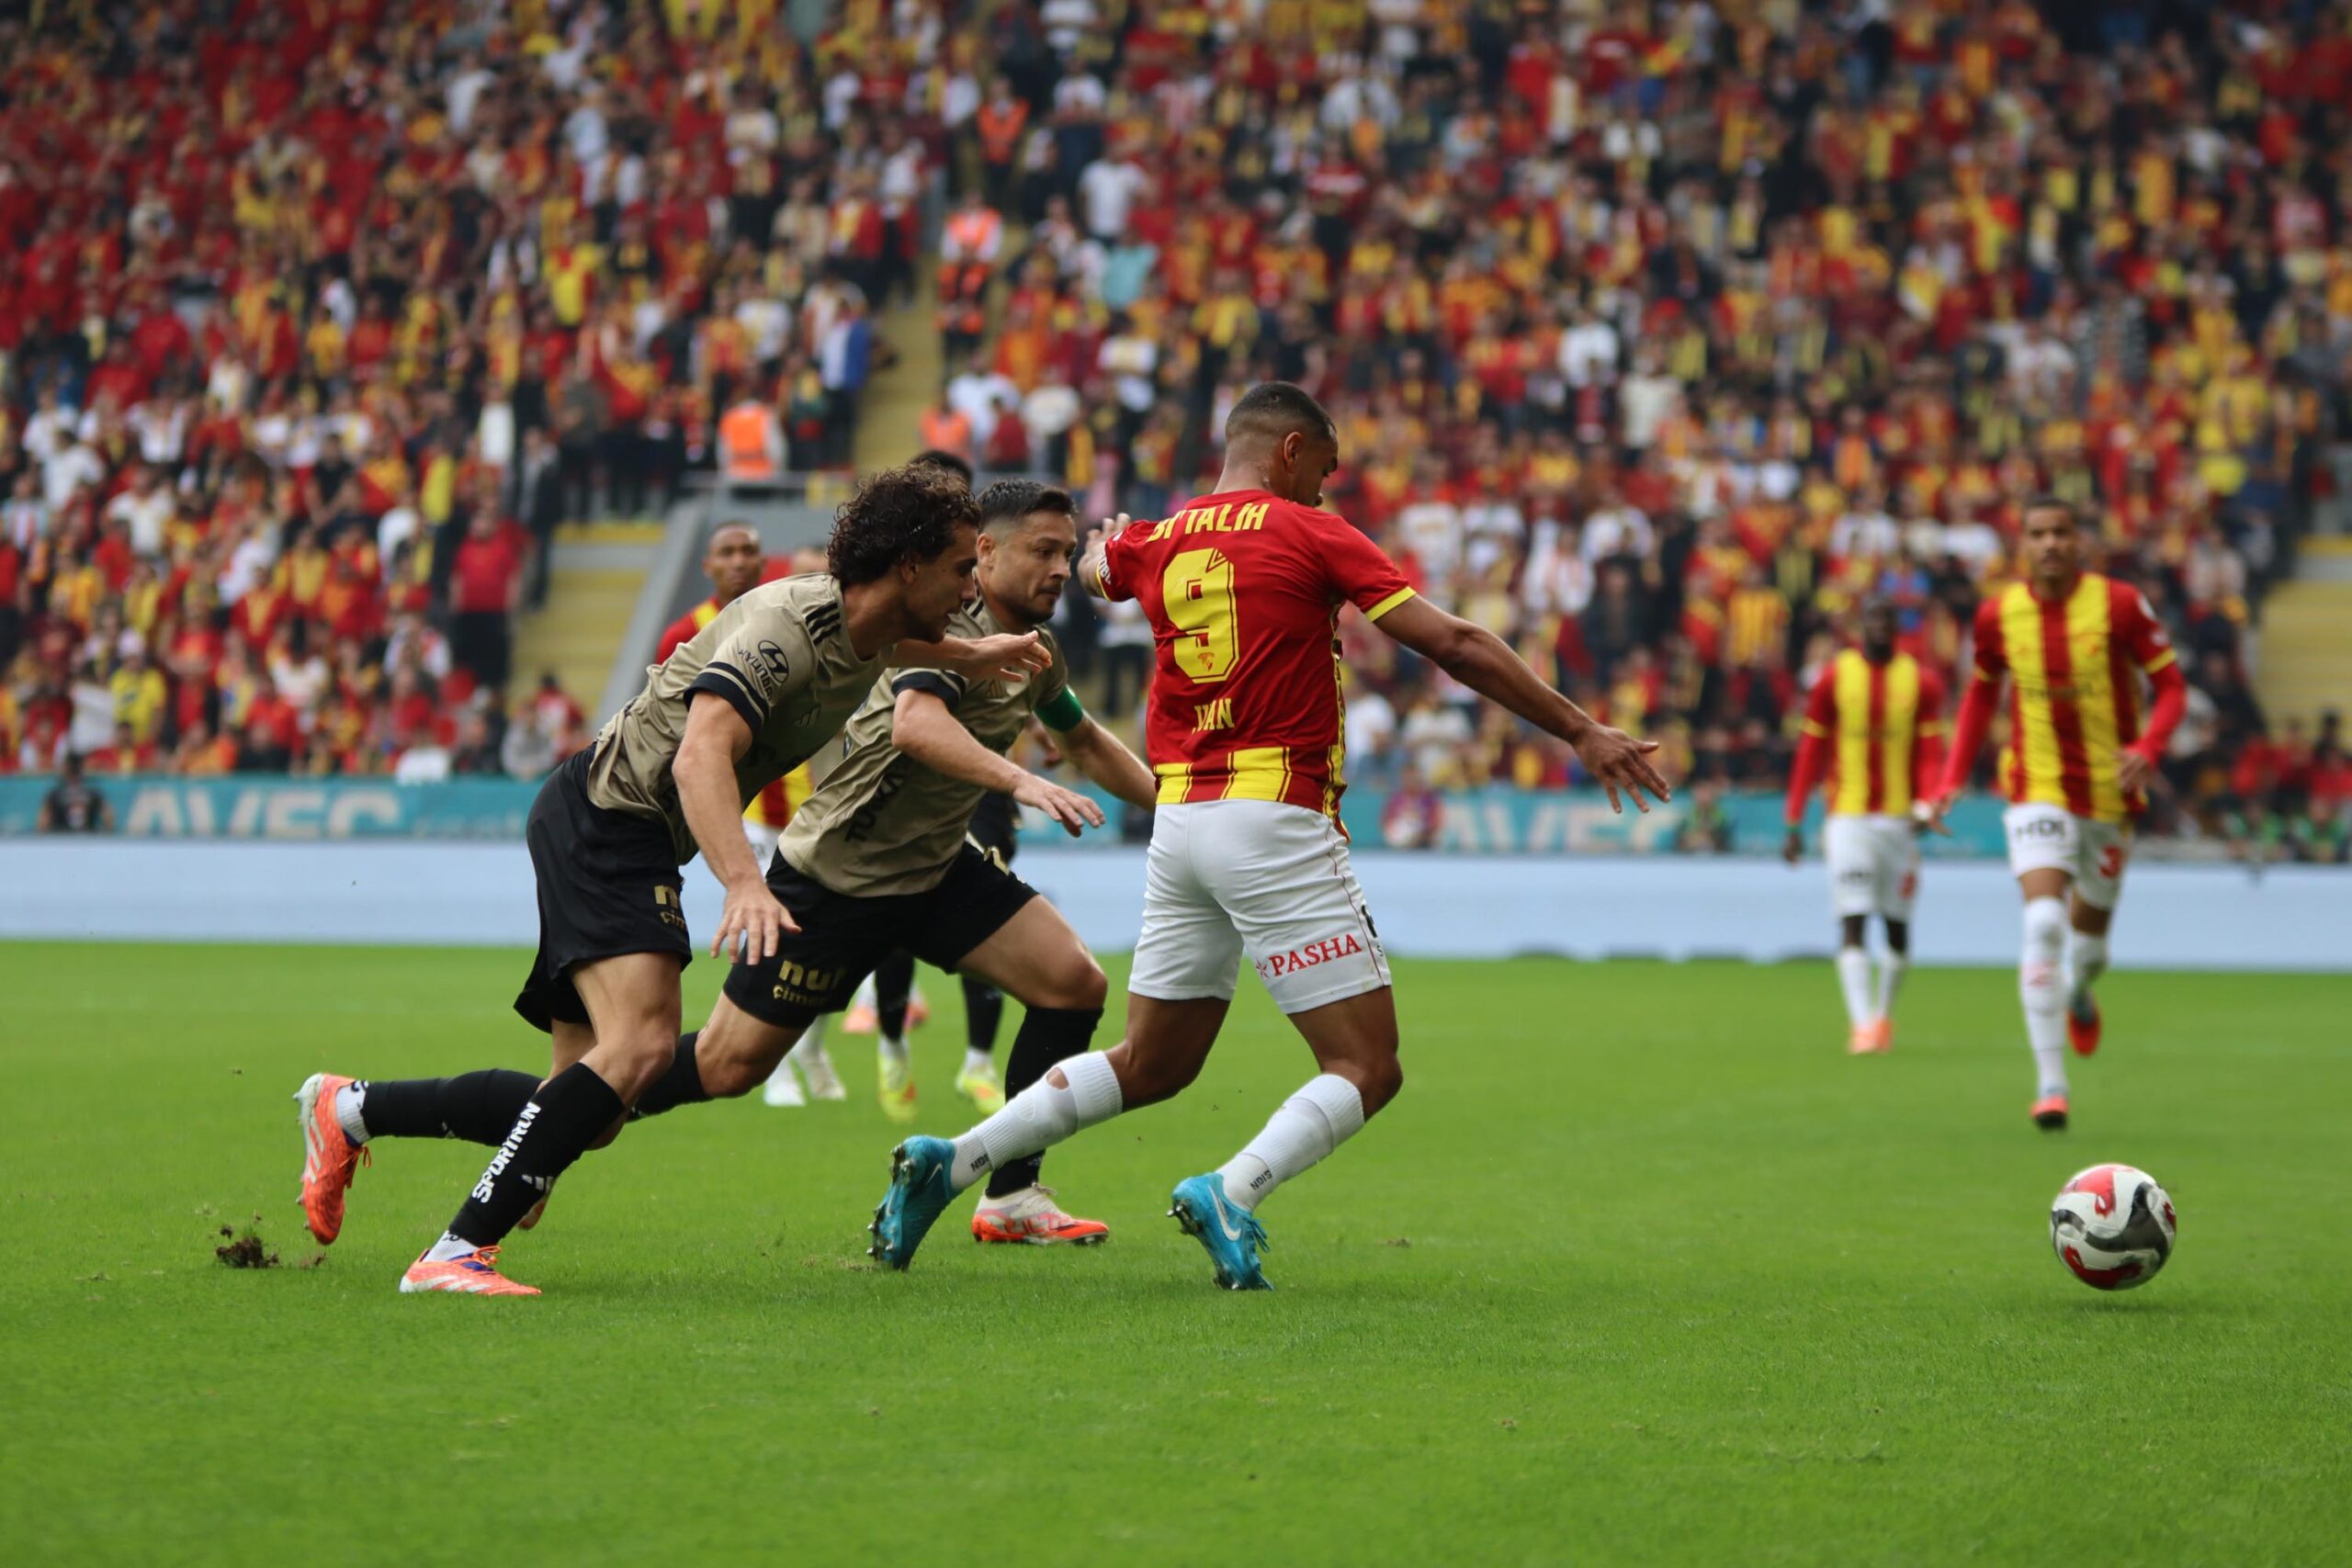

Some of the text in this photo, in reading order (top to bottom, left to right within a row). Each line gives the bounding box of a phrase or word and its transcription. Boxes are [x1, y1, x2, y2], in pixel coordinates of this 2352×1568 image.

[1163, 547, 1239, 683] 9
[737, 649, 774, 701] HYUNDA
[1269, 933, 1363, 976] PASHA
[471, 1101, 542, 1203] SPORTRUN
